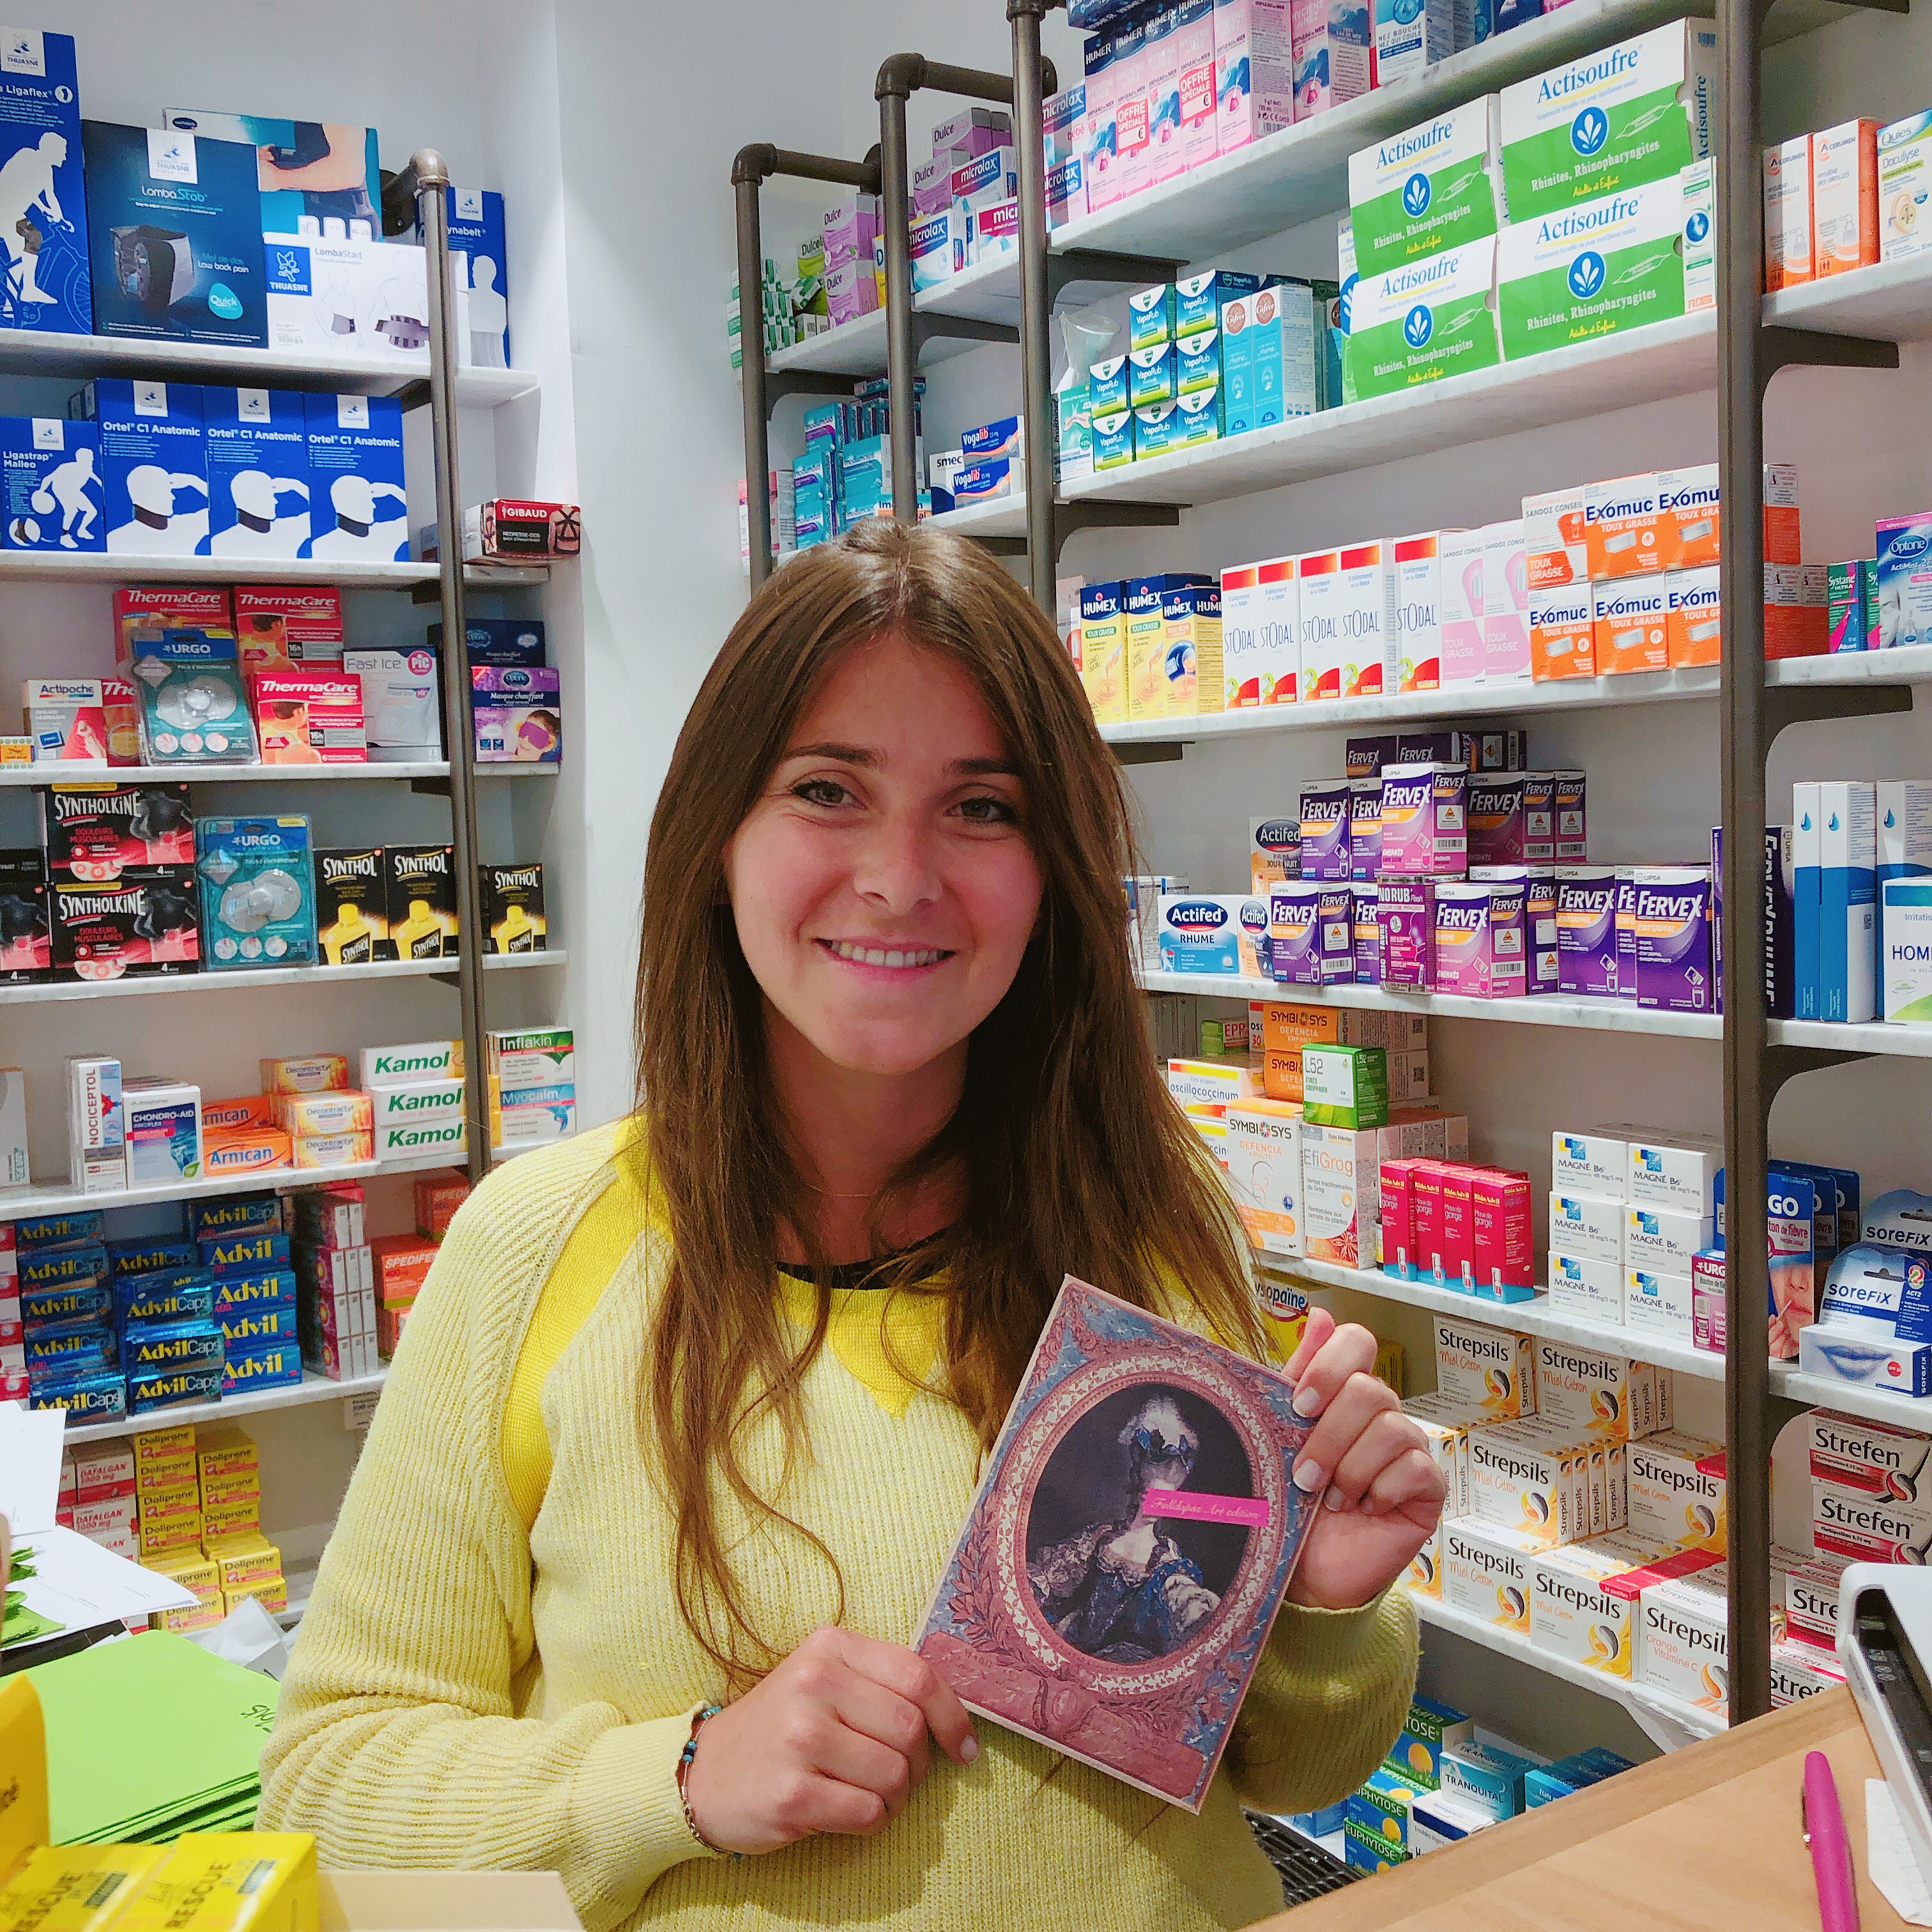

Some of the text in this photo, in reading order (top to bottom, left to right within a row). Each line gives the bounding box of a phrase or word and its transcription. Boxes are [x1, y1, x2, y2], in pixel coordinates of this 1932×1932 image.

[1116, 27, 1142, 49] HUMER
[1378, 33, 1390, 42] NEZ
[1379, 39, 1390, 49] NEZ
[1403, 31, 1422, 43] COULE
[1086, 43, 1111, 65] HUMER
[1181, 67, 1210, 91] OFFRE
[1537, 48, 1639, 104] Actisoufre
[1117, 102, 1146, 122] OFFRE
[1882, 126, 1912, 146] Quies
[1376, 121, 1452, 170] Actisoufre
[1531, 141, 1659, 192] Rhinites, Rhinopharyngites
[1882, 146, 1920, 169] Doculyse
[157, 161, 190, 174] THUASNE
[960, 159, 997, 183] microlax
[1536, 197, 1639, 245] Actisoufre
[1374, 226, 1406, 250] Rhinites,
[314, 247, 363, 260] LombaStart
[197, 260, 249, 274] Low back pain
[1380, 255, 1459, 298] Actisoufre
[269, 280, 309, 293] THUASNE
[210, 294, 237, 308] Quick
[1183, 295, 1208, 311] VapoRub
[1527, 288, 1657, 331] Rhinites, Rhinopharyngites
[1137, 365, 1162, 380] VapoRub
[1096, 378, 1119, 394] VapoRub
[103, 421, 130, 432] Ortel
[152, 425, 201, 437] Anatomic
[208, 427, 303, 442] Ortel Anatomic
[963, 427, 988, 446] Vogalib
[354, 436, 400, 448] Anatomic
[937, 456, 963, 467] smec
[954, 469, 980, 487] Vogalib
[1659, 486, 1719, 510] Exomu
[507, 507, 548, 518] GIBAUD
[1526, 500, 1583, 518] SANDOZ CONSEIL
[1586, 499, 1653, 521] Exomuc
[1601, 517, 1657, 533] TOUX GRASSE
[1529, 557, 1551, 569] TOUX
[1828, 574, 1855, 586] Systane
[128, 590, 220, 604] ThermaCare
[240, 593, 335, 609] ThermaCare
[1130, 592, 1162, 610] HUMEX
[1596, 595, 1662, 617] Exomuc
[1084, 598, 1116, 616] HUMEX
[1164, 601, 1191, 617] HUMEX
[1197, 601, 1222, 612] HUME
[1529, 606, 1588, 626] Exomuc
[1633, 615, 1665, 627] GRASSE
[1260, 621, 1294, 649] STODAL
[1303, 616, 1337, 643] STODAL
[1542, 627, 1562, 638] TOUX
[172, 644, 211, 654] URGO
[1224, 627, 1256, 654] STODAL
[1445, 647, 1475, 658] GRASSE
[346, 658, 401, 670] Fast Ice
[261, 680, 358, 693] ThermaCare
[1383, 783, 1430, 807] FERVEX
[1301, 799, 1347, 821] FERVEX
[242, 835, 280, 846] URGO
[323, 853, 377, 878] SYNTHOL
[394, 853, 447, 876] SYNTHOL
[494, 870, 538, 890] SYNTHOL
[1273, 901, 1317, 925] FERVEX
[1637, 891, 1703, 921] FERVEX
[1172, 908, 1222, 923] Actifed
[1241, 908, 1266, 926] Actifed
[1180, 934, 1215, 944] RHUME
[1280, 1025, 1319, 1037] DEFENCIA
[502, 1035, 551, 1050] Inflakin
[375, 1052, 449, 1073] Kamol
[1305, 1058, 1323, 1075] L52
[1356, 1055, 1367, 1064] L52
[388, 1088, 462, 1112] Kamol
[502, 1089, 558, 1105] Myocalm
[1170, 1082, 1239, 1101] oscillococcinum
[88, 1068, 100, 1146] NOCICEPTOL
[133, 1109, 194, 1123] CHONDRO-AID
[388, 1123, 463, 1147] Kamol
[210, 1147, 272, 1165] Arnican
[1239, 1140, 1282, 1156] DEFENCIA
[1248, 1151, 1273, 1160] ADULTE
[1304, 1149, 1353, 1177] EfiGrog
[1558, 1160, 1590, 1170] MAGNÉ
[1634, 1171, 1666, 1183] MAGNÉ
[1381, 1199, 1399, 1210] gorge
[1415, 1205, 1432, 1215] gorge
[1445, 1211, 1462, 1222] gorge
[211, 1239, 272, 1266] Advil
[215, 1278, 279, 1305] Advil
[1439, 1328, 1510, 1363] Strepsils
[222, 1353, 282, 1379] Advil
[1542, 1347, 1619, 1383] Strepsils
[1815, 1428, 1900, 1468] Strefen
[1473, 1445, 1549, 1485] Strepsils
[1633, 1457, 1719, 1498] Strepsils
[1821, 1498, 1910, 1540] Strefen
[1646, 1607, 1728, 1655] Strepsil
[1646, 1634, 1679, 1654] Orange
[1653, 1647, 1698, 1673] Vitamine C
[1445, 1773, 1504, 1804] TRANQUITAL
[1345, 1823, 1396, 1860] EUPHYTOSE
